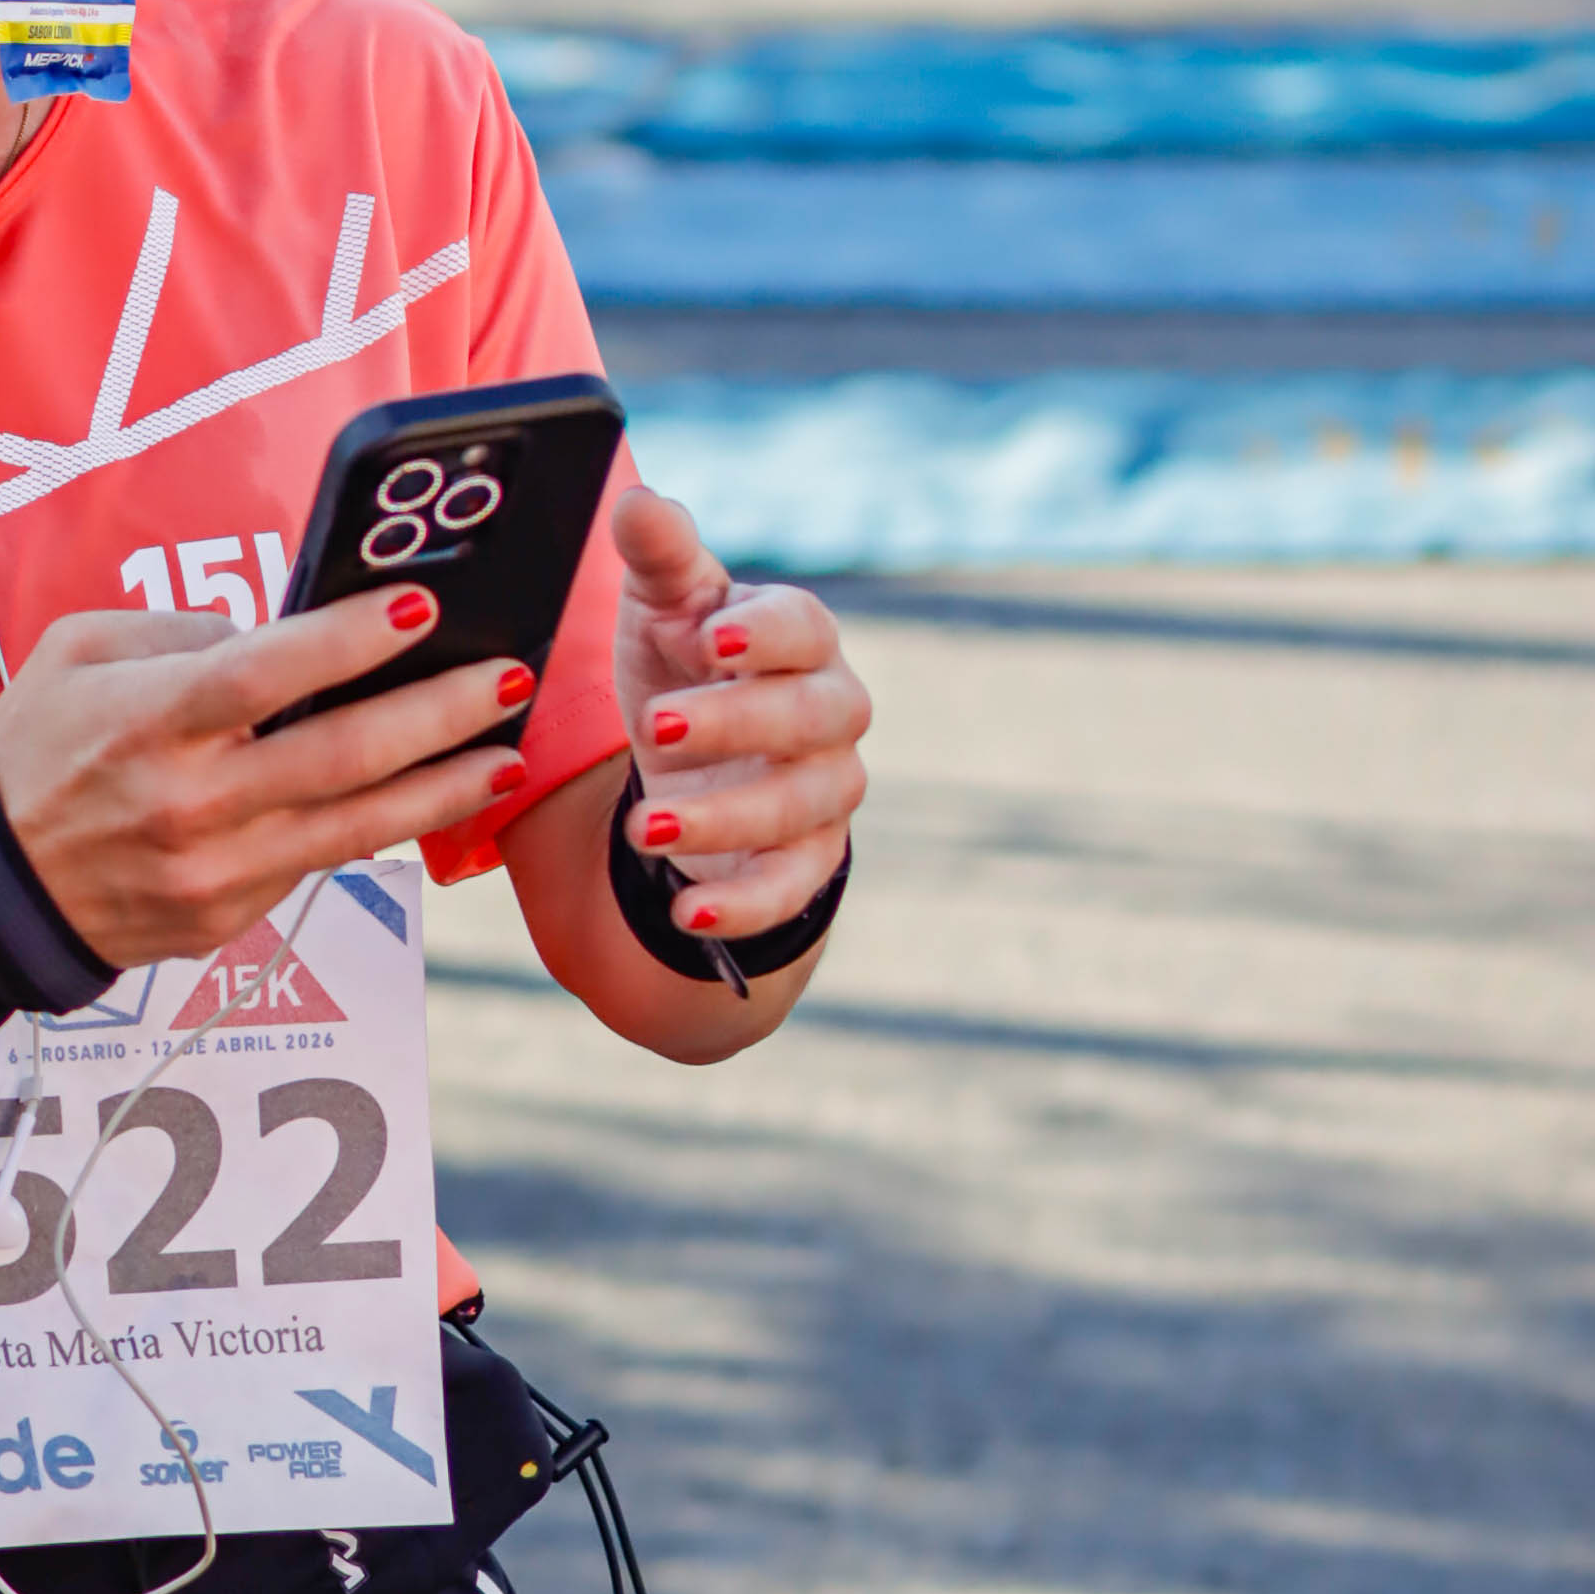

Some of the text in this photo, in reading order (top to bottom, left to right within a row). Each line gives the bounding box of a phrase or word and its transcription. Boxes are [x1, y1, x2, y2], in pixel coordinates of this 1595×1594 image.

[210, 961, 303, 1011] 15K
[41, 1042, 127, 1062] ROSARIO
[151, 1040, 172, 1057] 12
[183, 1037, 207, 1055] DE
[215, 1034, 277, 1054] ABRIL
[285, 1031, 335, 1050] 2026
[45, 1324, 163, 1368] María
[171, 1314, 325, 1358] Victoria
[247, 1440, 343, 1463] POWER
